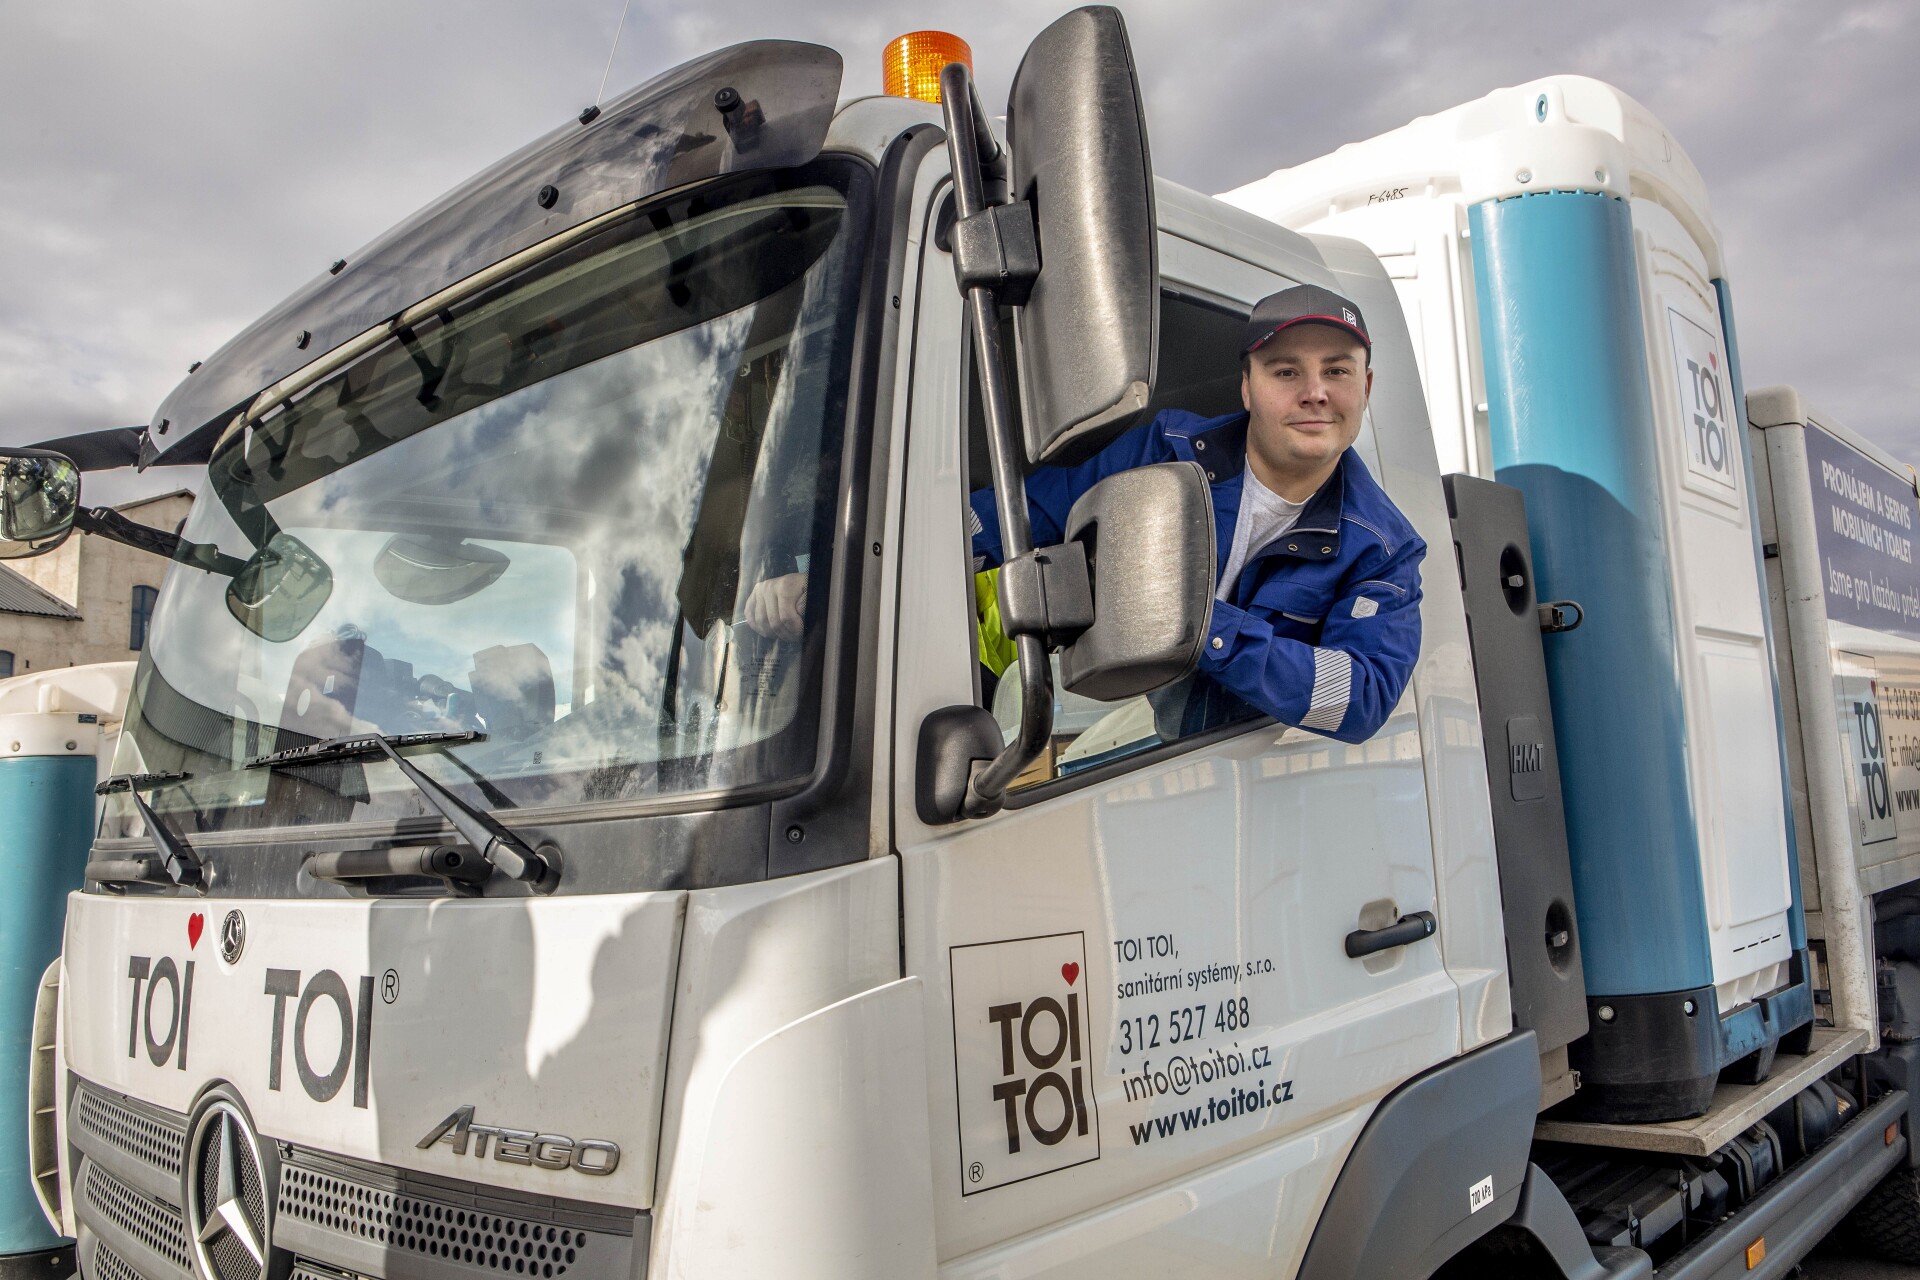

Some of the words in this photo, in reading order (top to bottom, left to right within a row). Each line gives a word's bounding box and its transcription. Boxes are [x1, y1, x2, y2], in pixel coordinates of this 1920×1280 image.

[1687, 358, 1724, 422] TOI
[1694, 414, 1729, 475] TOI
[1822, 460, 1875, 513] PRONÁJEM
[1877, 490, 1884, 517] A
[1884, 494, 1911, 530] SERVIS
[1832, 505, 1883, 552] MOBILNÍCH
[1883, 531, 1911, 564] TOALET
[1828, 556, 1853, 599] Jsme
[1854, 578, 1870, 611] pro
[1869, 570, 1901, 613] každou
[1854, 701, 1884, 759] TOI
[1894, 687, 1910, 720] 312
[1512, 743, 1544, 774] HMT
[1861, 761, 1892, 820] TOI
[1114, 938, 1143, 963] TOI
[1147, 934, 1179, 960] TOI,
[1117, 969, 1182, 1000] sanitární
[1187, 963, 1242, 992] systémy,
[1246, 958, 1276, 977] s.r.o.
[128, 955, 195, 1071] TOI
[264, 967, 375, 1109] TOI
[988, 992, 1082, 1077] TOI
[1119, 1014, 1161, 1055] 312
[1169, 1004, 1207, 1044] 527
[1214, 996, 1250, 1033] 488
[1121, 1042, 1272, 1103] info@toitoi.cz
[415, 1104, 621, 1176] ATEGO
[992, 1066, 1089, 1155] TOI
[1129, 1079, 1294, 1146] www.toitoi.cz
